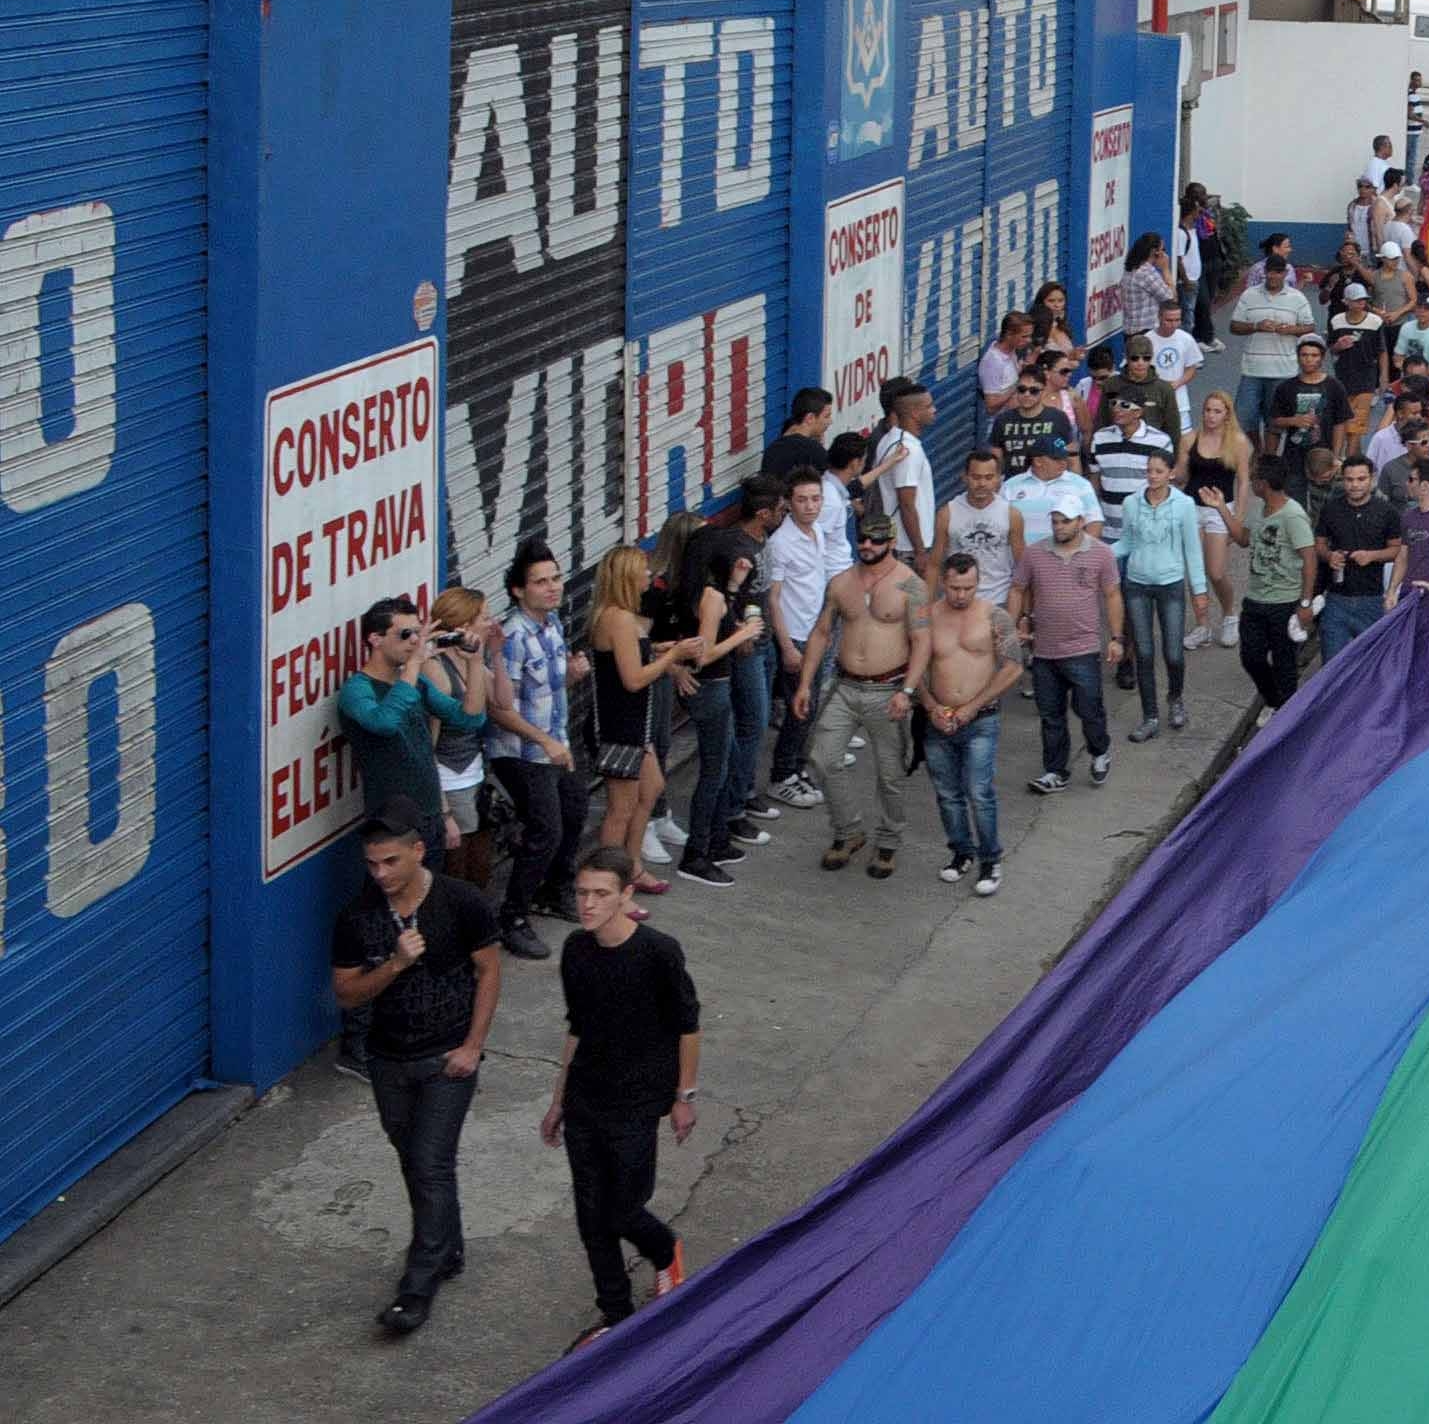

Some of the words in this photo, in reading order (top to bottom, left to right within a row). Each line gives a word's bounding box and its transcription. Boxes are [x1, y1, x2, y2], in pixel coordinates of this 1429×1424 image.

[446, 17, 776, 300] AUTO
[829, 206, 899, 276] CONSERTO
[854, 288, 873, 329] DE
[834, 344, 889, 413] VIDRO
[272, 375, 432, 497] CONSERTO
[445, 292, 767, 616] VIDRO
[1003, 421, 1054, 436] FITCH
[271, 531, 314, 616] DE
[323, 482, 427, 587] TRAVA
